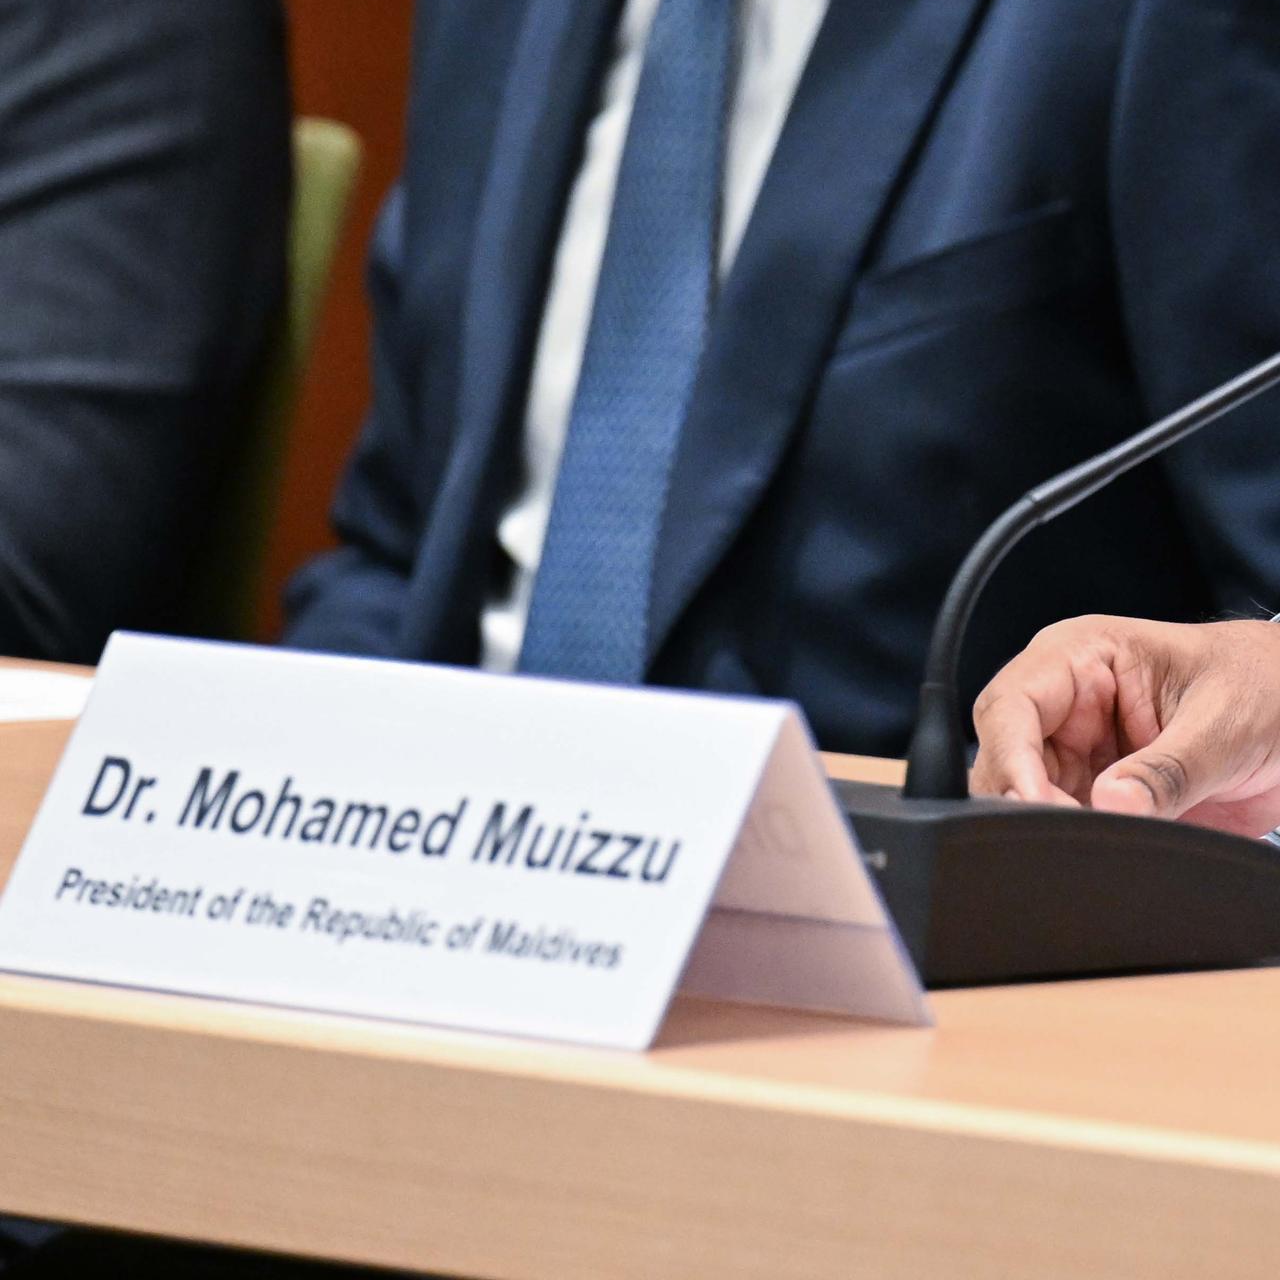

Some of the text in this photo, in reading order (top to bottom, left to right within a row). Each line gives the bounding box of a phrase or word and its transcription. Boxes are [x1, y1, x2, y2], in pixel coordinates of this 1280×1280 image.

[81, 756, 156, 824] Dr.
[177, 767, 467, 857] Mohamed
[473, 801, 681, 883] Muizzu
[55, 867, 623, 969] President of the Republic of Maldives
